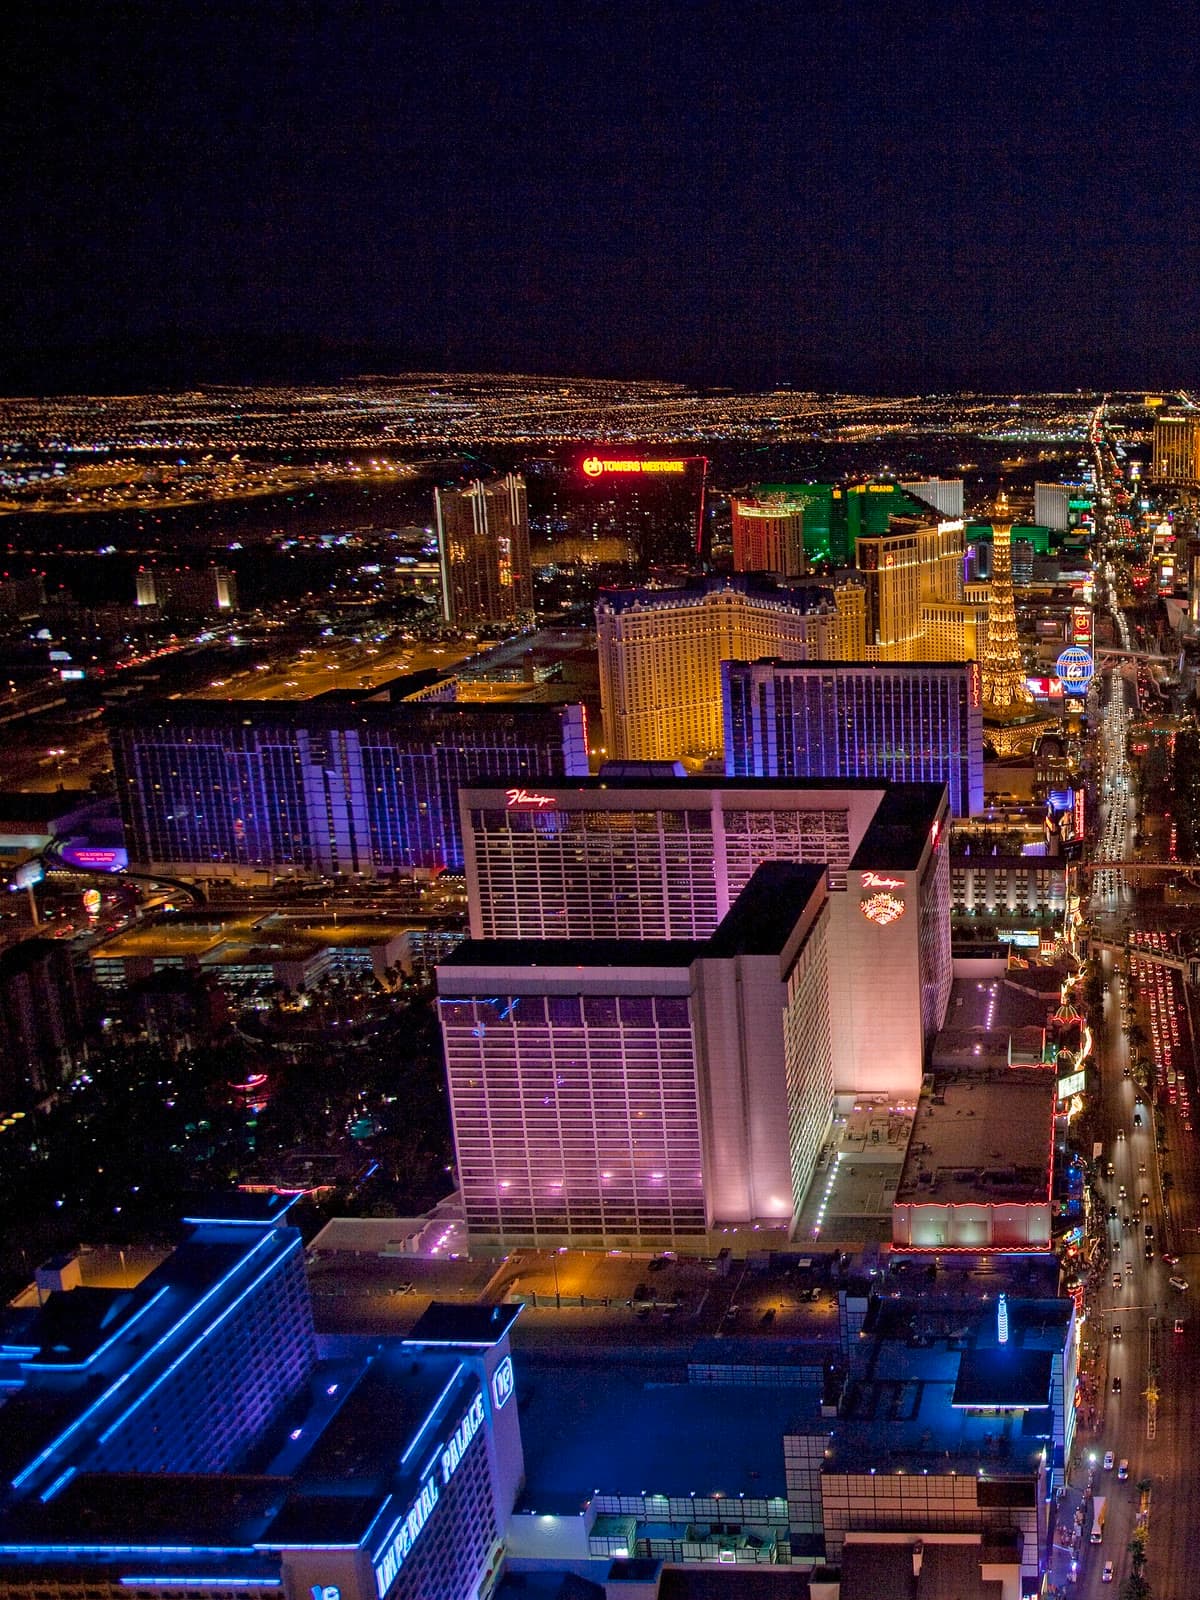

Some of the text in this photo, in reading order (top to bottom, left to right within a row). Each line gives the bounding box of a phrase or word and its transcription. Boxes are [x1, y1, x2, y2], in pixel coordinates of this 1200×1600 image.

[602, 461, 641, 472] TOWERS
[869, 484, 894, 493] GRAND
[506, 789, 556, 807] Flamingo
[861, 872, 905, 890] Flamingo
[375, 1392, 485, 1599] IMPERIAL PALACE
